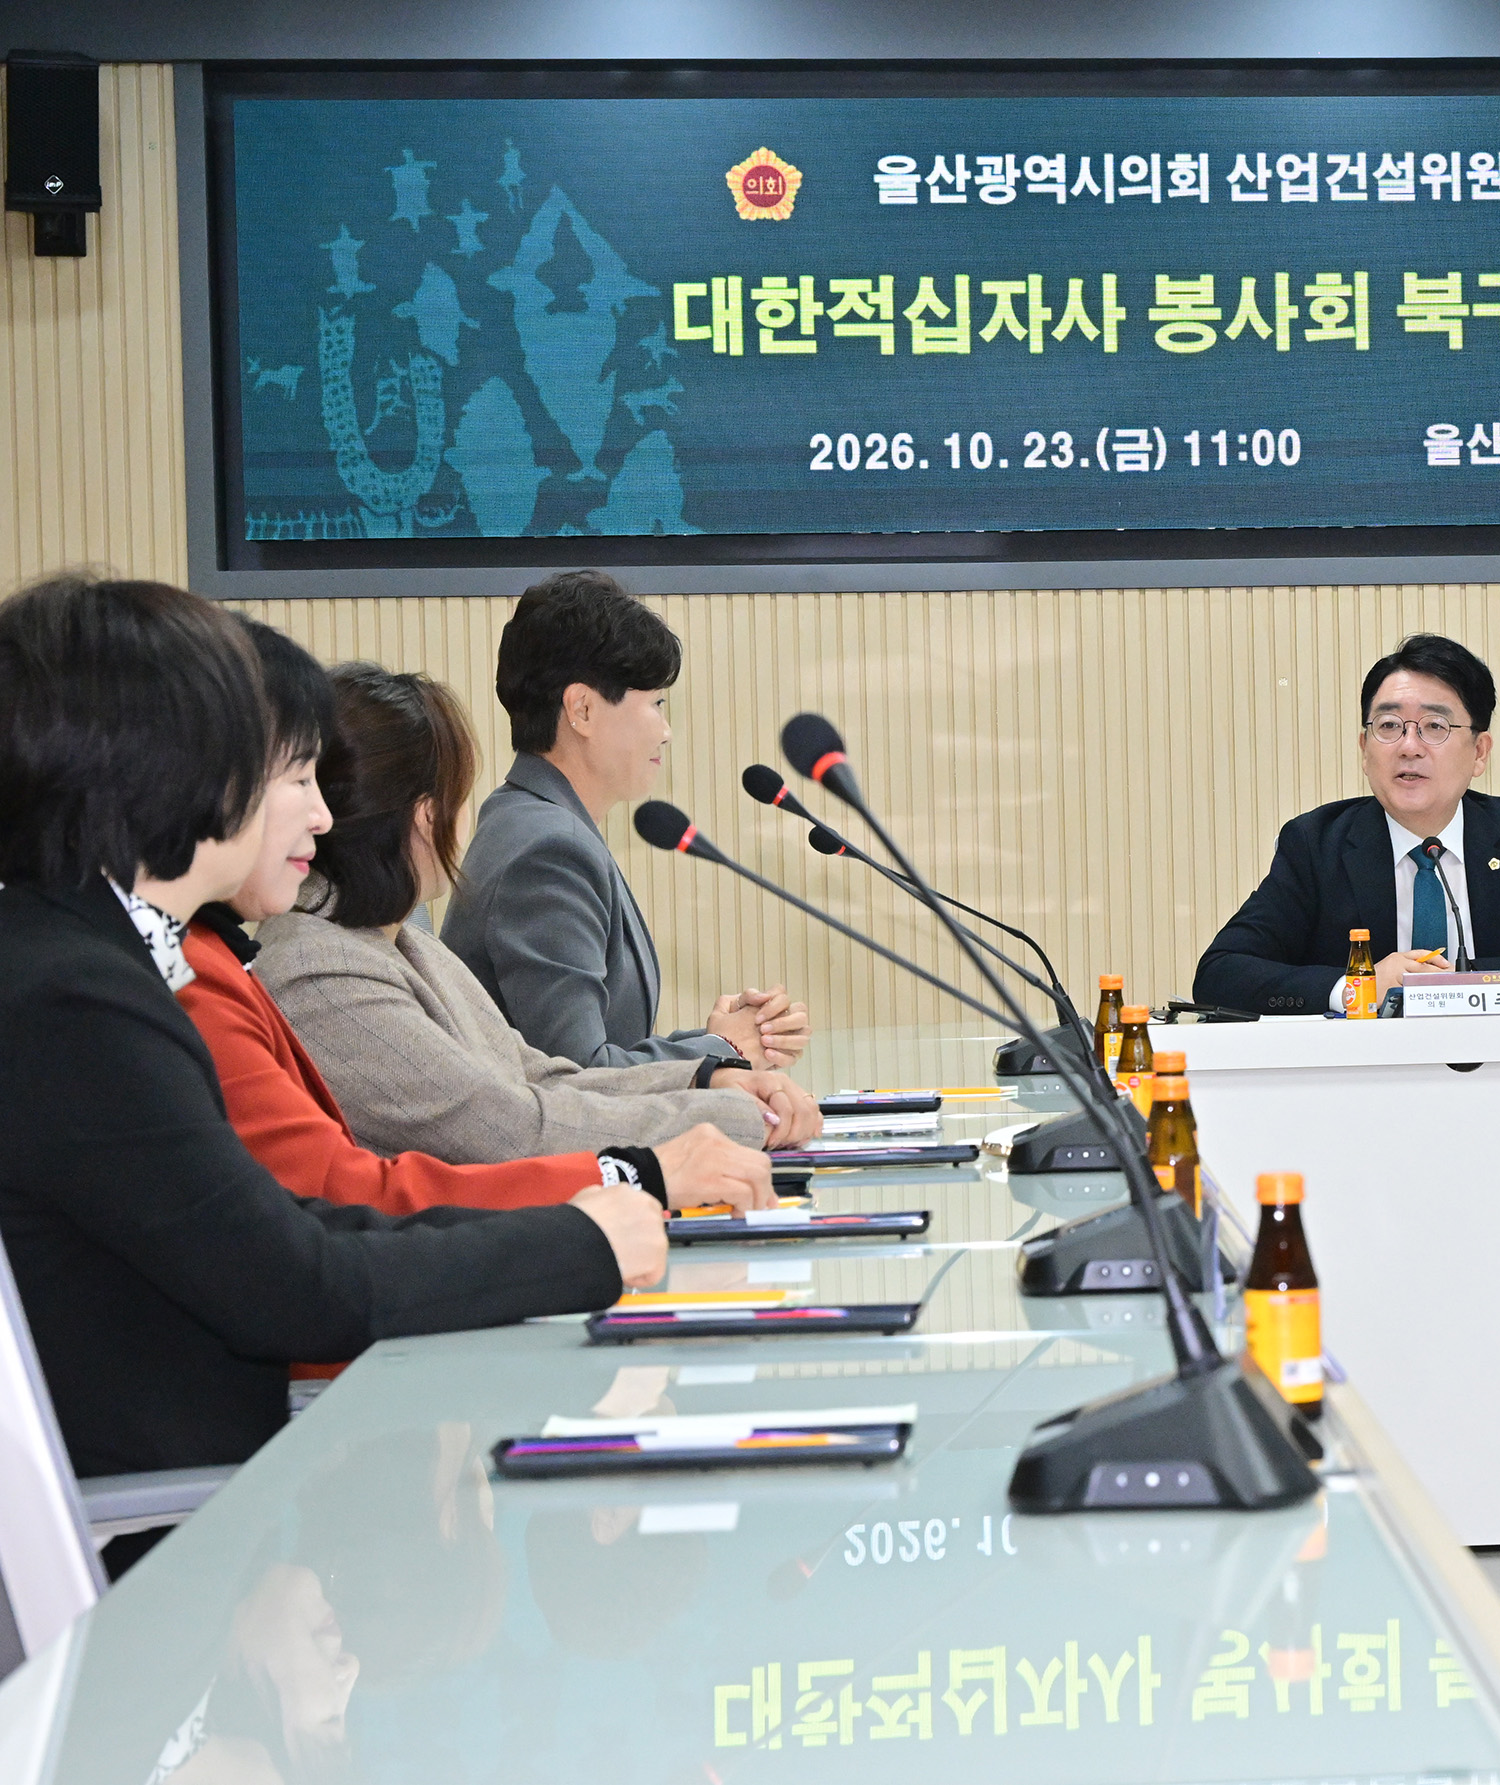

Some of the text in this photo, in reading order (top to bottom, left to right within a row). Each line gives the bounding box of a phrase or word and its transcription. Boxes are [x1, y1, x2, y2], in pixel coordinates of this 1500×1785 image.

[743, 174, 785, 198] 의회
[873, 152, 1210, 205] 울산광역시의회
[673, 273, 1127, 356] 대한적십자사
[1148, 271, 1370, 354] 봉사회
[809, 426, 1301, 473] 2026. 10. 23.(금) 11:00
